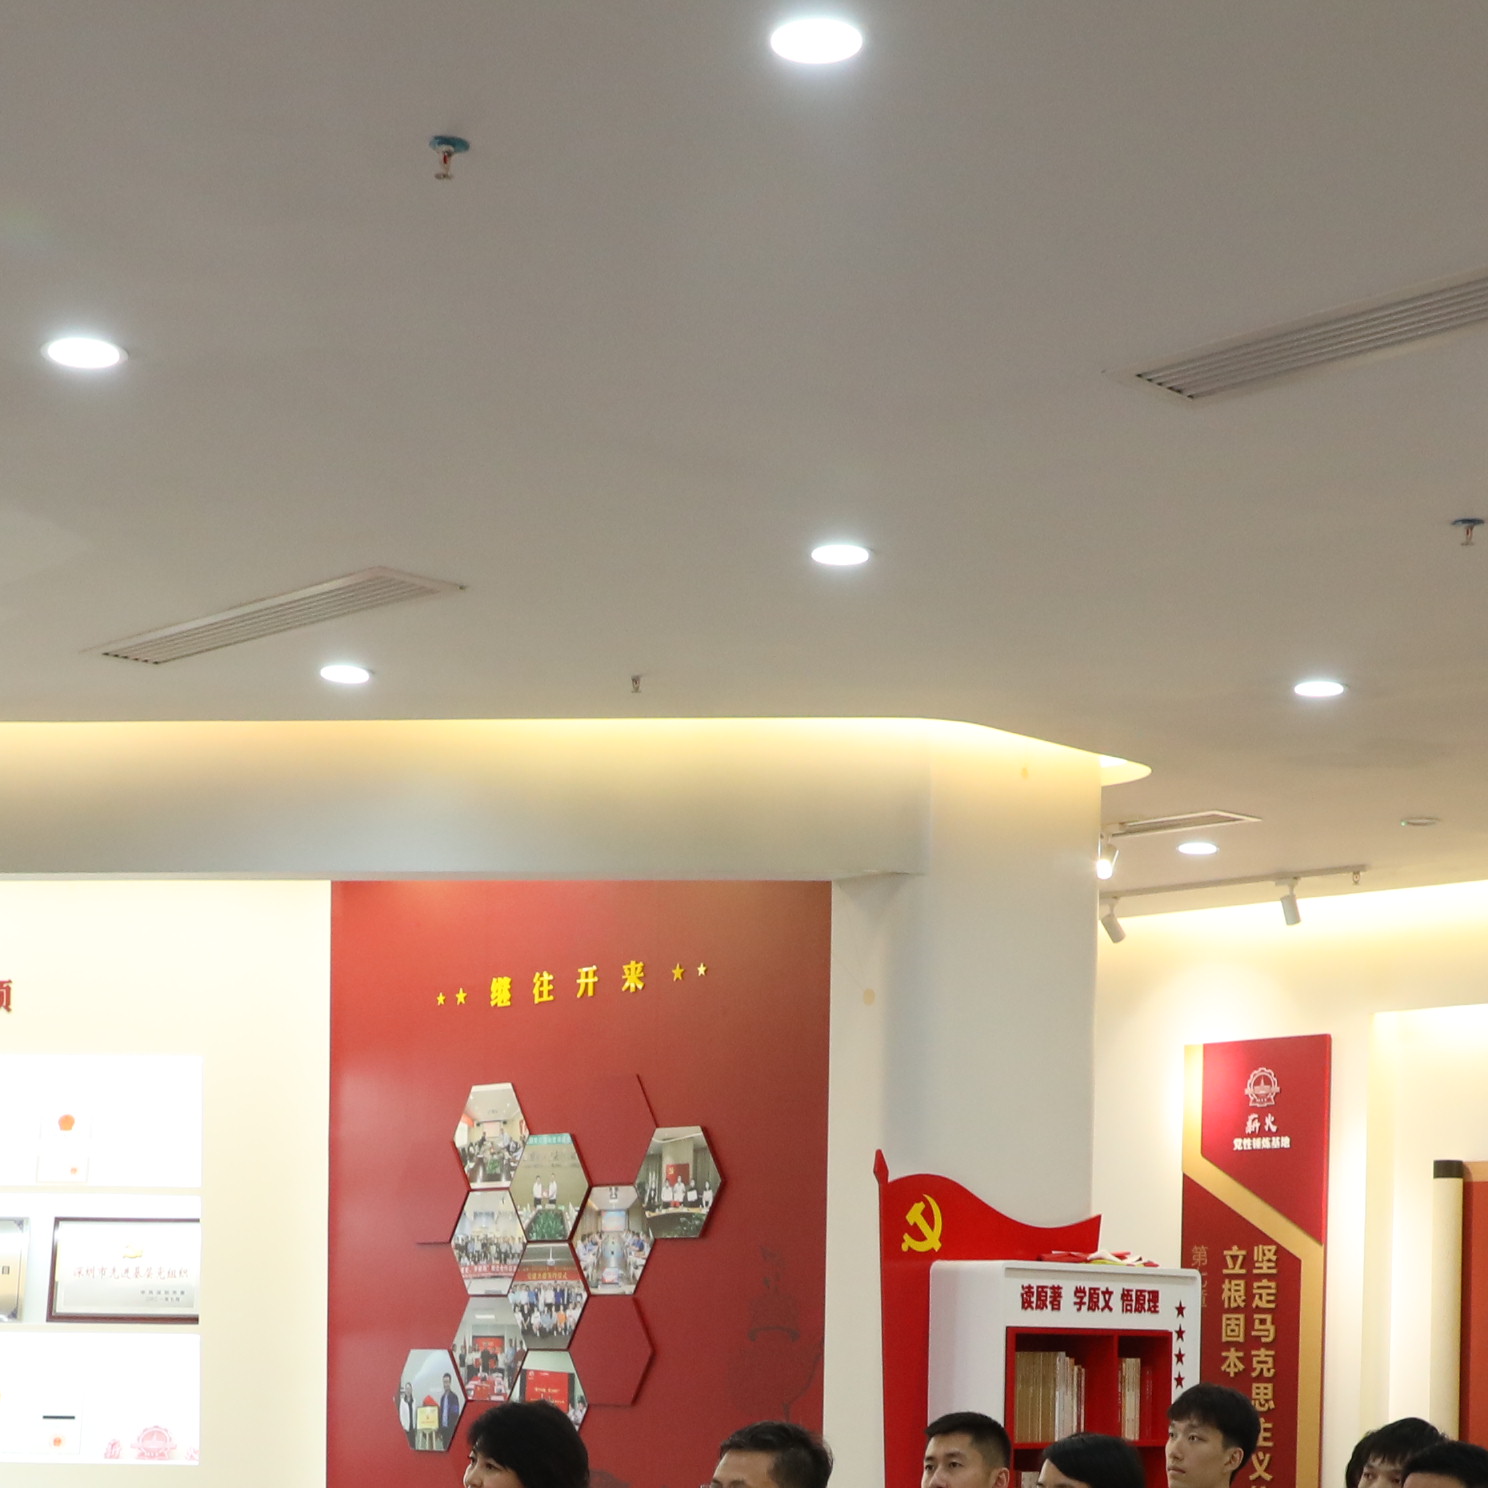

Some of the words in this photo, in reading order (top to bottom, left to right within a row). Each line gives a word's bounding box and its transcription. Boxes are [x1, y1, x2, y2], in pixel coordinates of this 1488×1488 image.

[490, 960, 646, 1008] 继往开来
[1020, 1284, 1063, 1312] 读原著
[1073, 1285, 1114, 1312] 学原文
[1120, 1287, 1160, 1314] 悟原理
[1220, 1245, 1247, 1378] 立根固本
